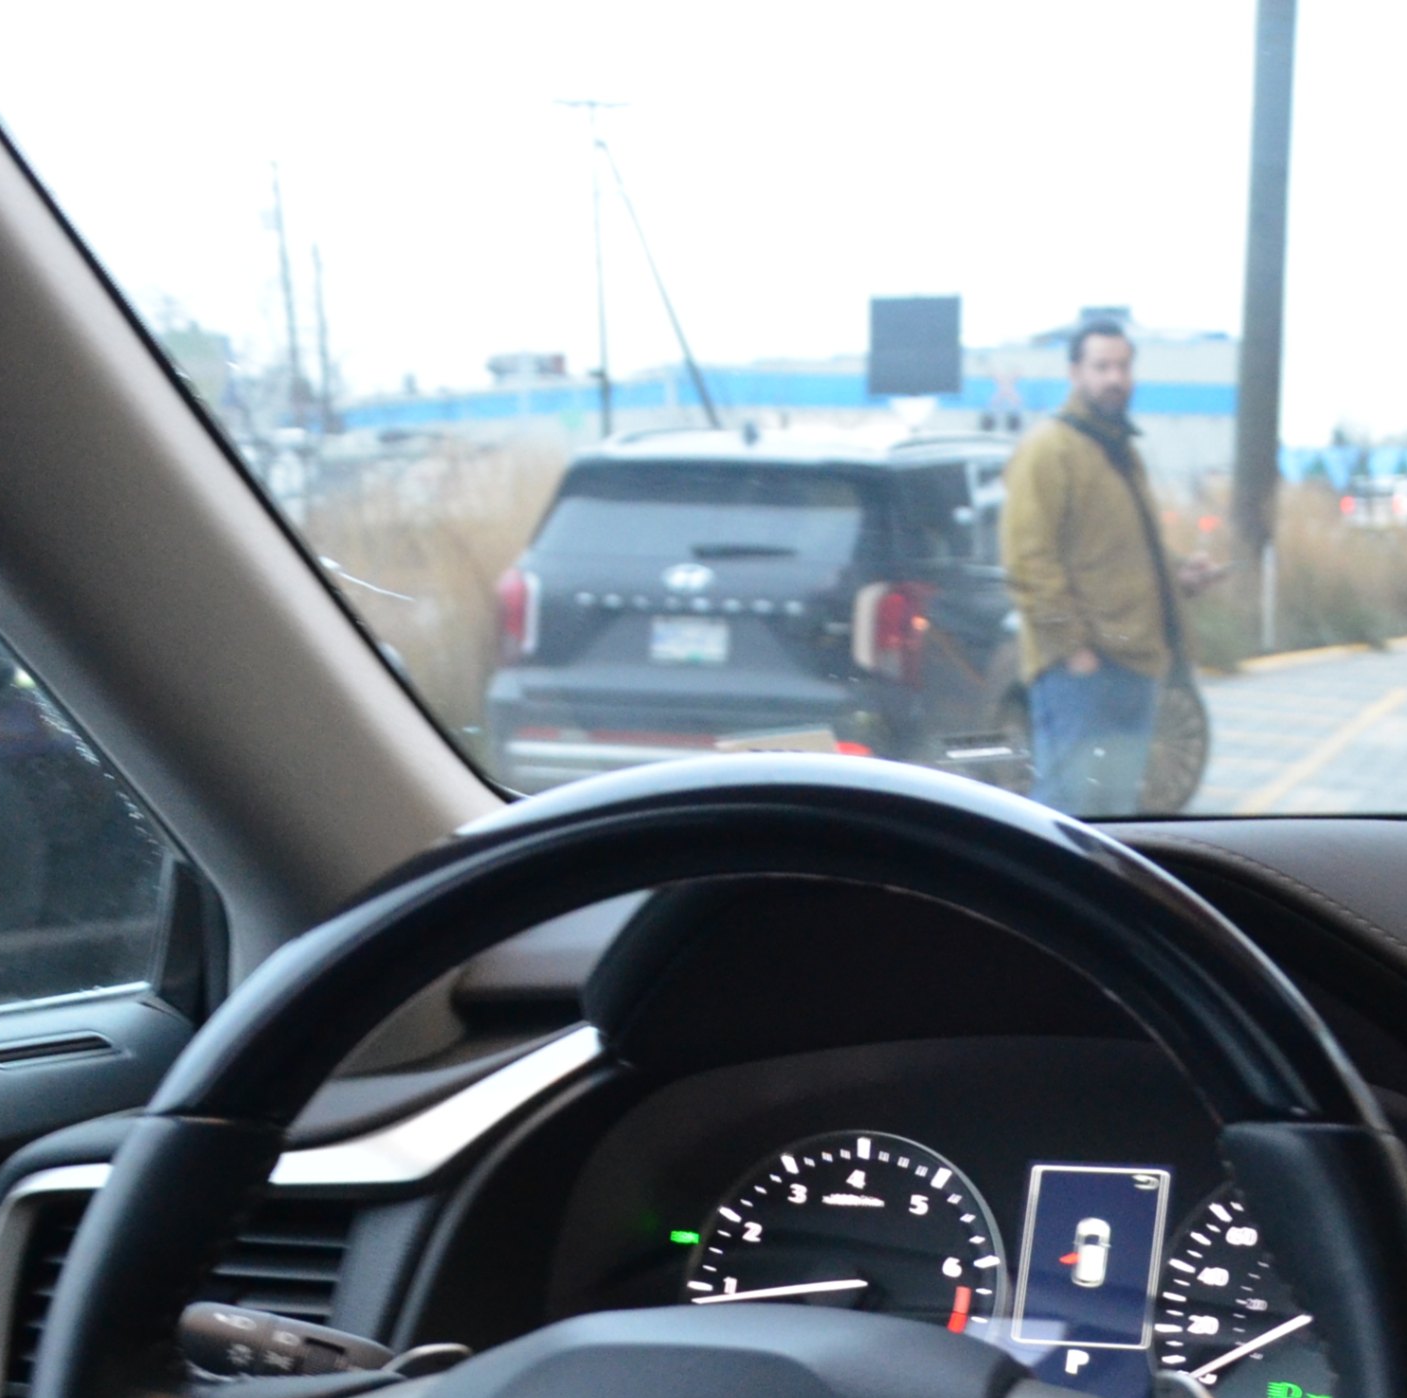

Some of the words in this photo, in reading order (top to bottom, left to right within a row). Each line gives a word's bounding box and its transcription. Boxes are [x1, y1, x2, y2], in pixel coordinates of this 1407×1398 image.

[847, 1169, 866, 1189] 4
[788, 1183, 807, 1204] 3
[909, 1195, 929, 1216] 5
[742, 1222, 762, 1243] 2
[942, 1257, 962, 1278] 6
[1197, 1267, 1229, 1287] 40
[1187, 1315, 1220, 1335] 20
[1065, 1349, 1090, 1374] P
